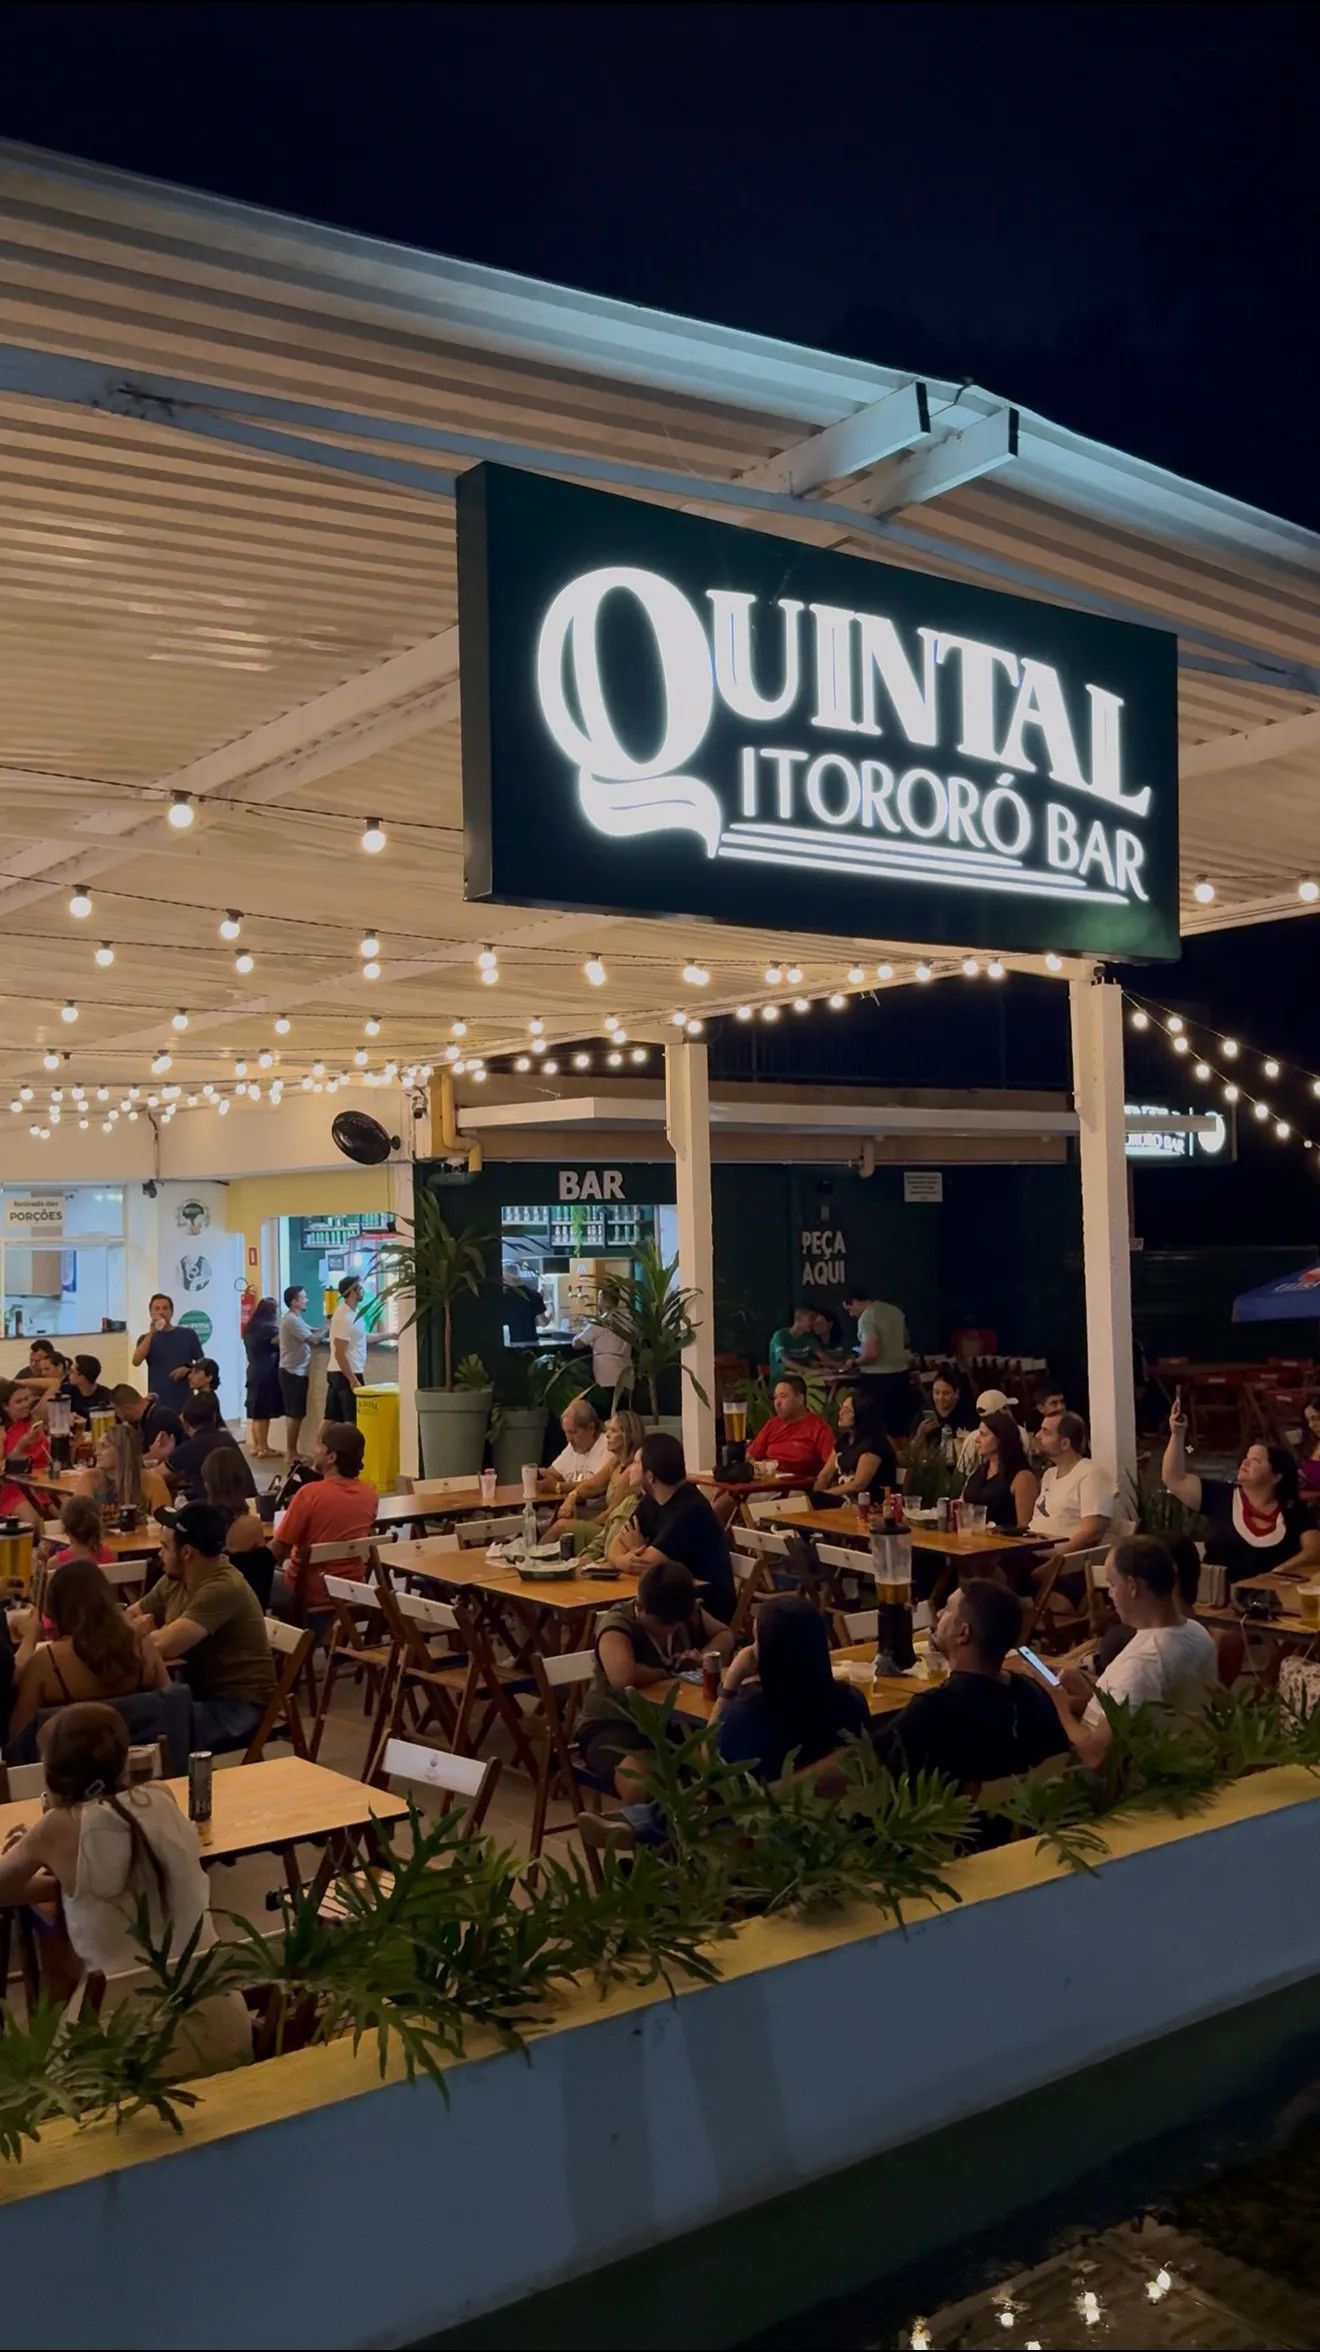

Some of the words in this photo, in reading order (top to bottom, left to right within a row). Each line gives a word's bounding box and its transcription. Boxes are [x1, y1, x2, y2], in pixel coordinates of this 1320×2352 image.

[538, 565, 1151, 858] QUINTAL
[741, 747, 1031, 855] ITORORÓ
[1046, 803, 1149, 901] BAR
[559, 1170, 626, 1200] BAR
[10, 1208, 63, 1224] PORÇÕES
[802, 1230, 847, 1260] PEÇA
[802, 1260, 846, 1286] AQUI
